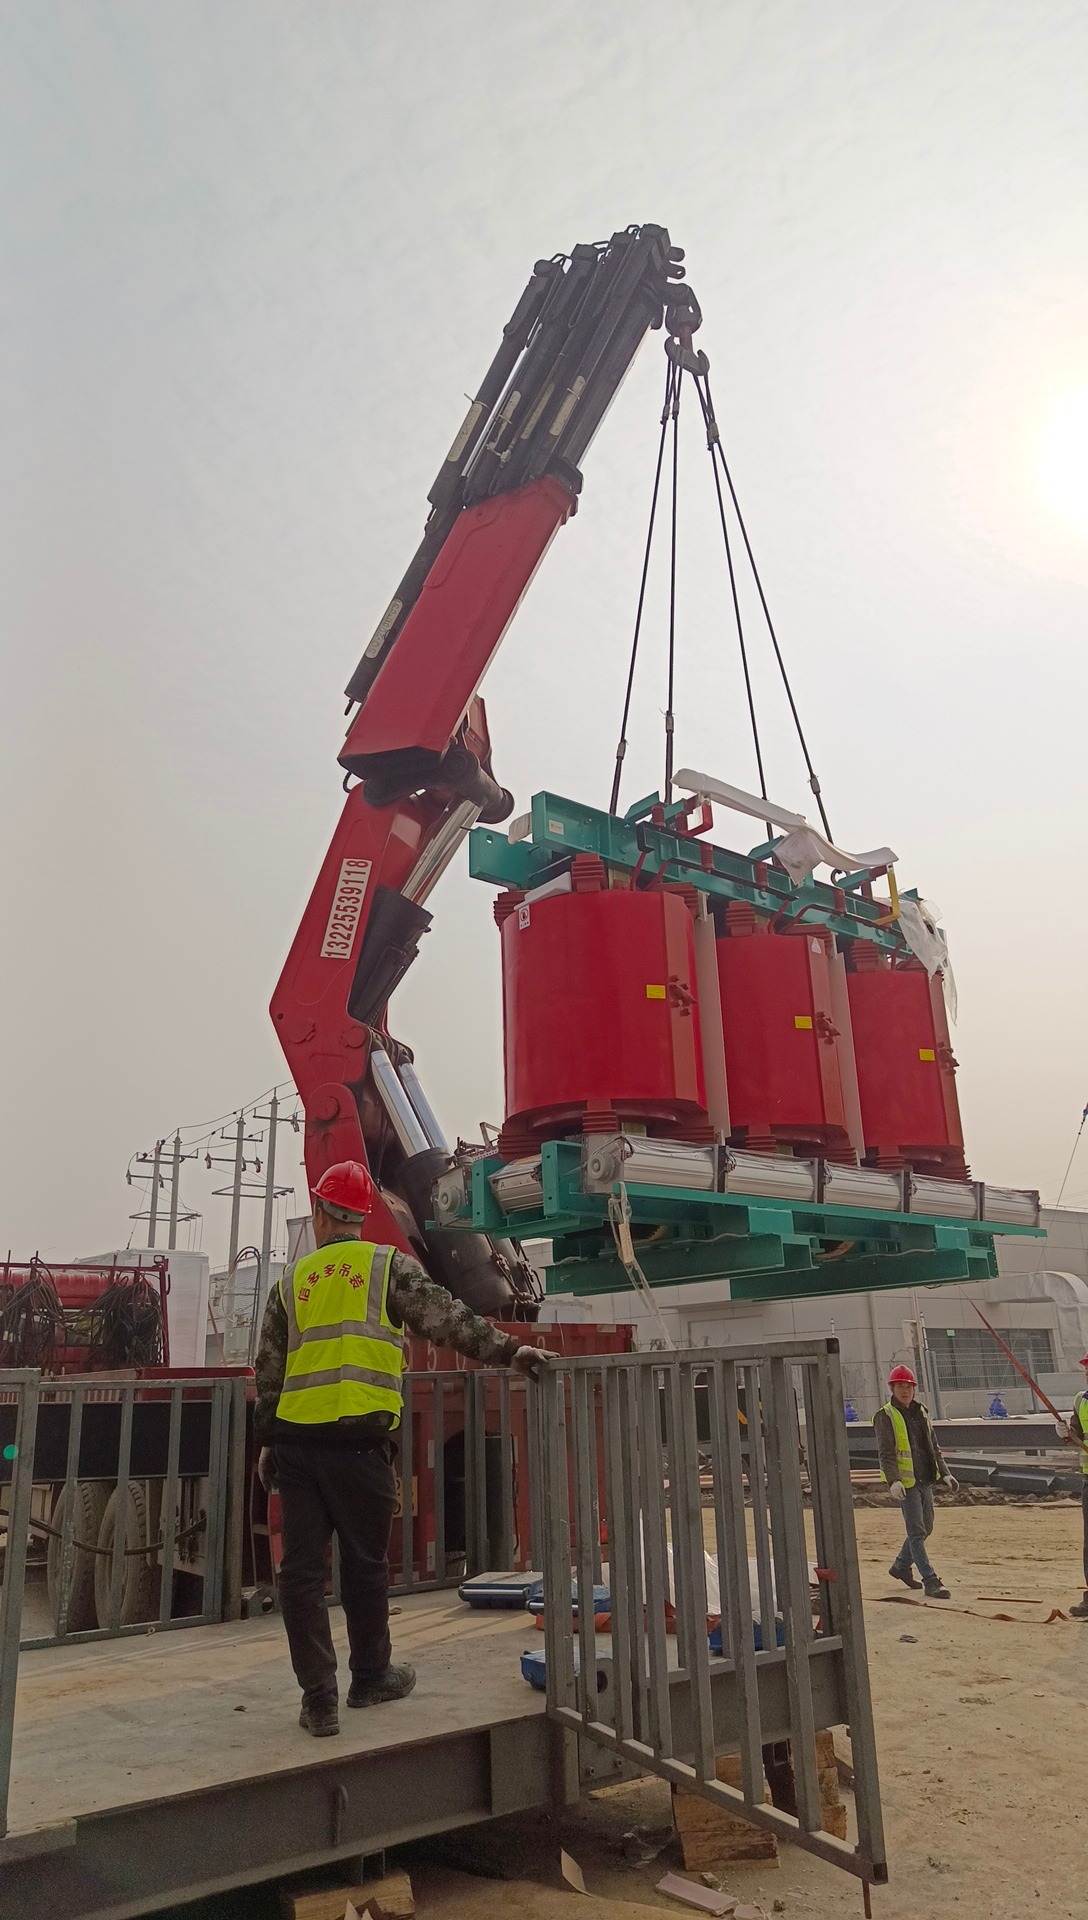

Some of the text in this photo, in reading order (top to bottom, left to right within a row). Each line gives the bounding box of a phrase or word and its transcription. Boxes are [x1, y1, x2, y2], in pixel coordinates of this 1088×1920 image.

[325, 860, 369, 957] 13225539118
[298, 1263, 365, 1302] 信多多吊装
